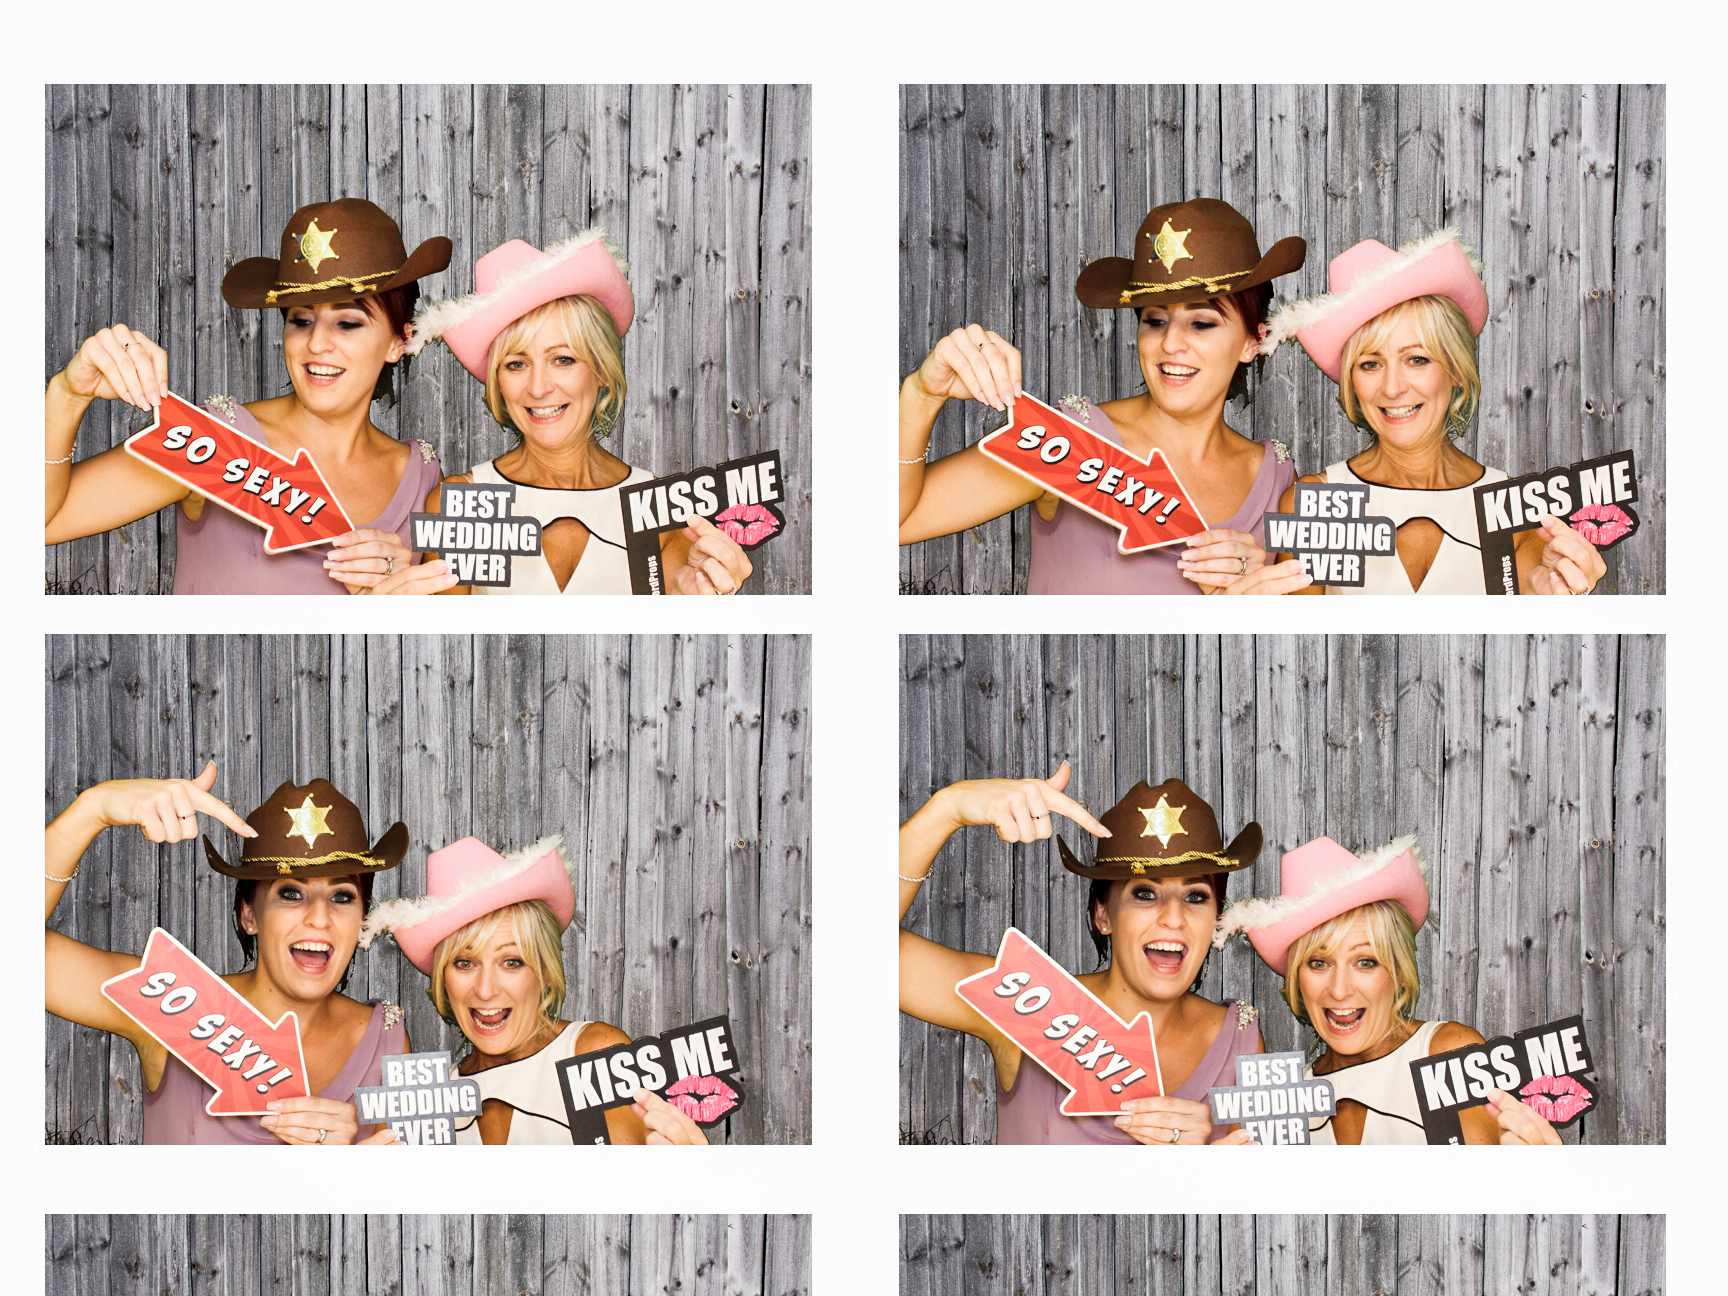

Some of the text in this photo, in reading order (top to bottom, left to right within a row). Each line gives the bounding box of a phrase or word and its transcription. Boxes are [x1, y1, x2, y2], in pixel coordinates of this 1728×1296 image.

[162, 425, 327, 525] SO SEXY!
[1016, 425, 1181, 525] SO SEXY!
[446, 489, 511, 518] BEST
[628, 460, 779, 533] KISS ME
[1300, 489, 1365, 518] BEST
[1482, 460, 1633, 533] KISS ME
[415, 520, 537, 551] WEDDING
[1269, 520, 1391, 551] WEDDING
[445, 552, 506, 581] EVER
[1299, 552, 1360, 581] EVER
[139, 971, 293, 1094] SO SEXY!
[993, 971, 1147, 1094] SO SEXY!
[387, 1058, 447, 1087] BEST
[566, 1026, 734, 1111] KISS ME
[1241, 1058, 1301, 1087] BEST
[1420, 1026, 1588, 1111] KISS ME
[360, 1085, 476, 1119] WEDDING
[1214, 1085, 1330, 1119] WEDDING
